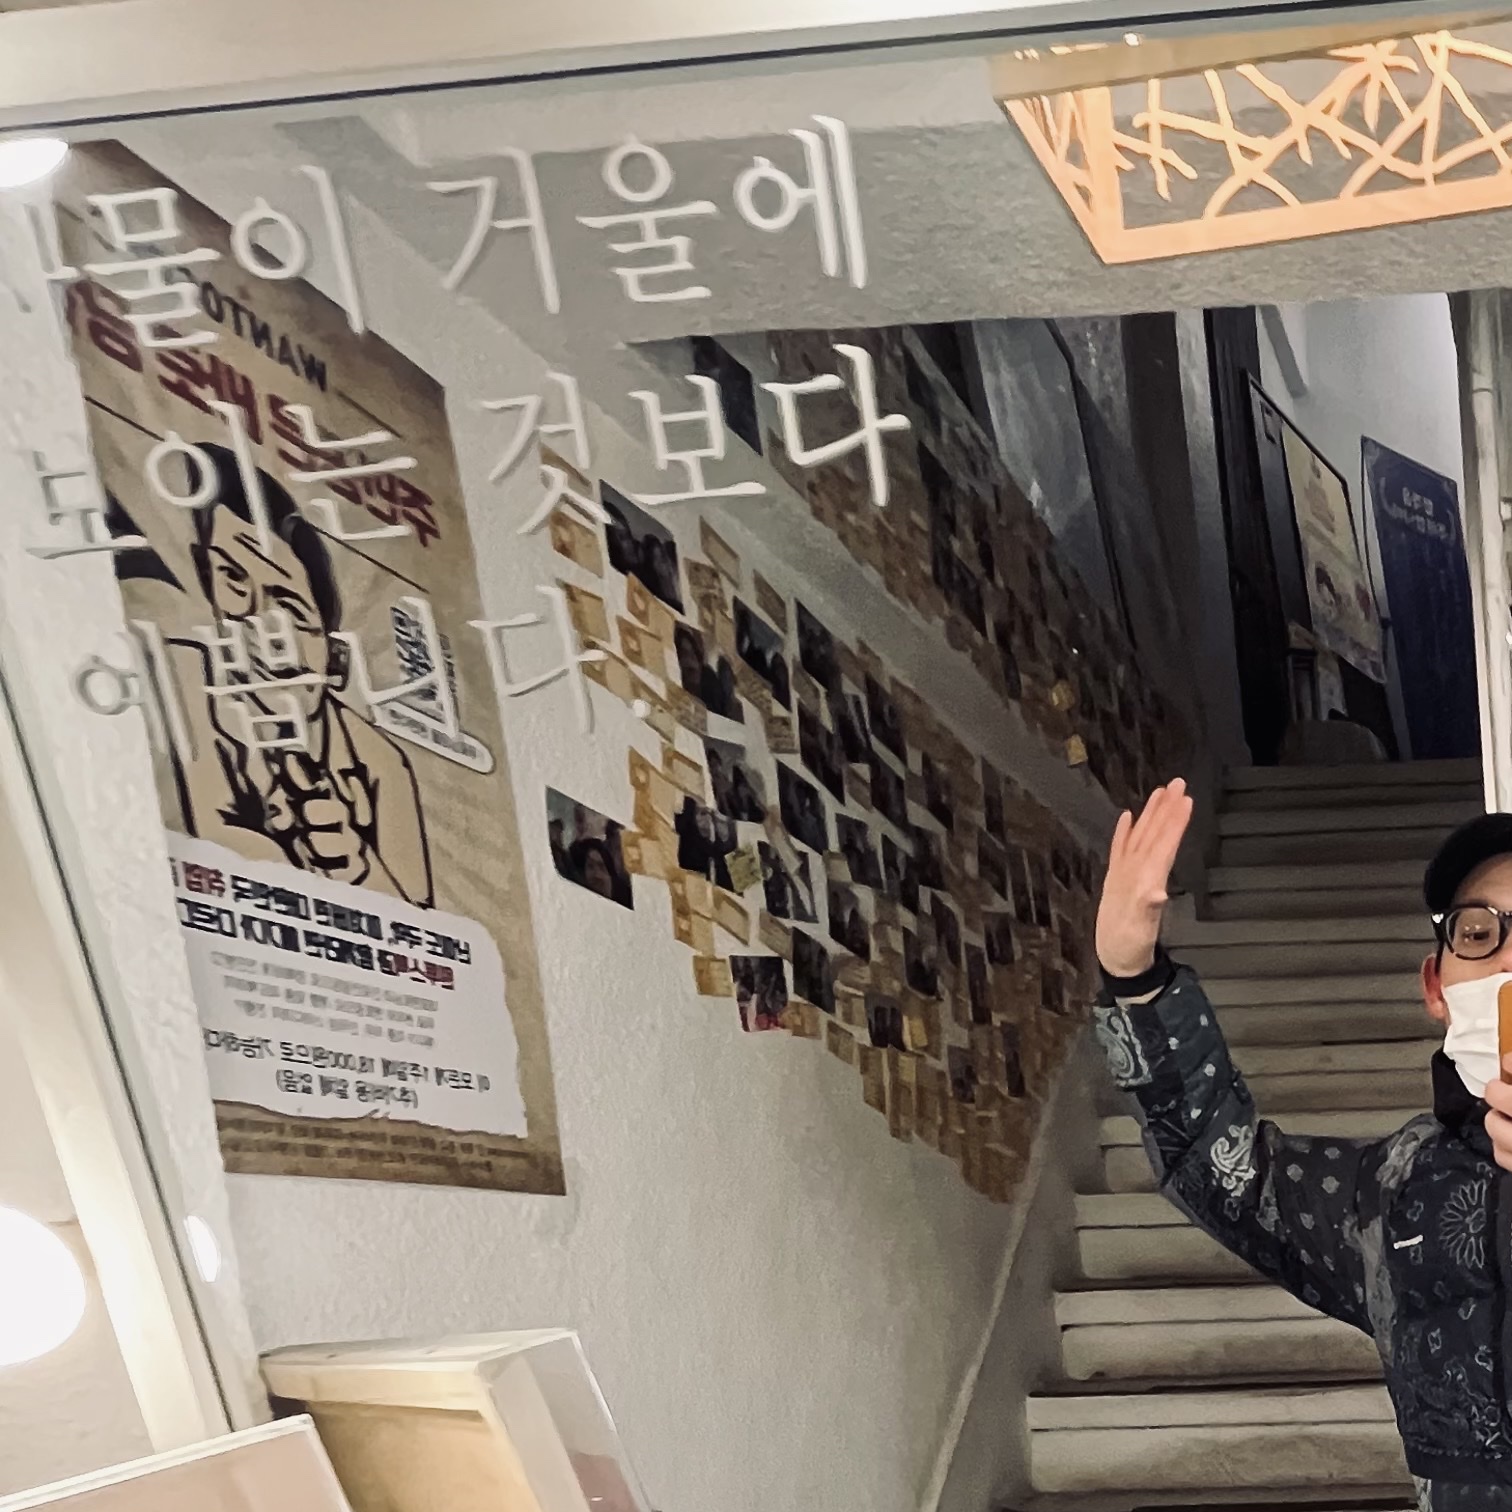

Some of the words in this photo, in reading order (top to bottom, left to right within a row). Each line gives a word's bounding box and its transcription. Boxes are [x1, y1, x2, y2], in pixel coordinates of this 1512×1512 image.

[426, 113, 868, 314] 거울에
[26, 399, 419, 560] 보이는
[479, 343, 912, 536] 것보다
